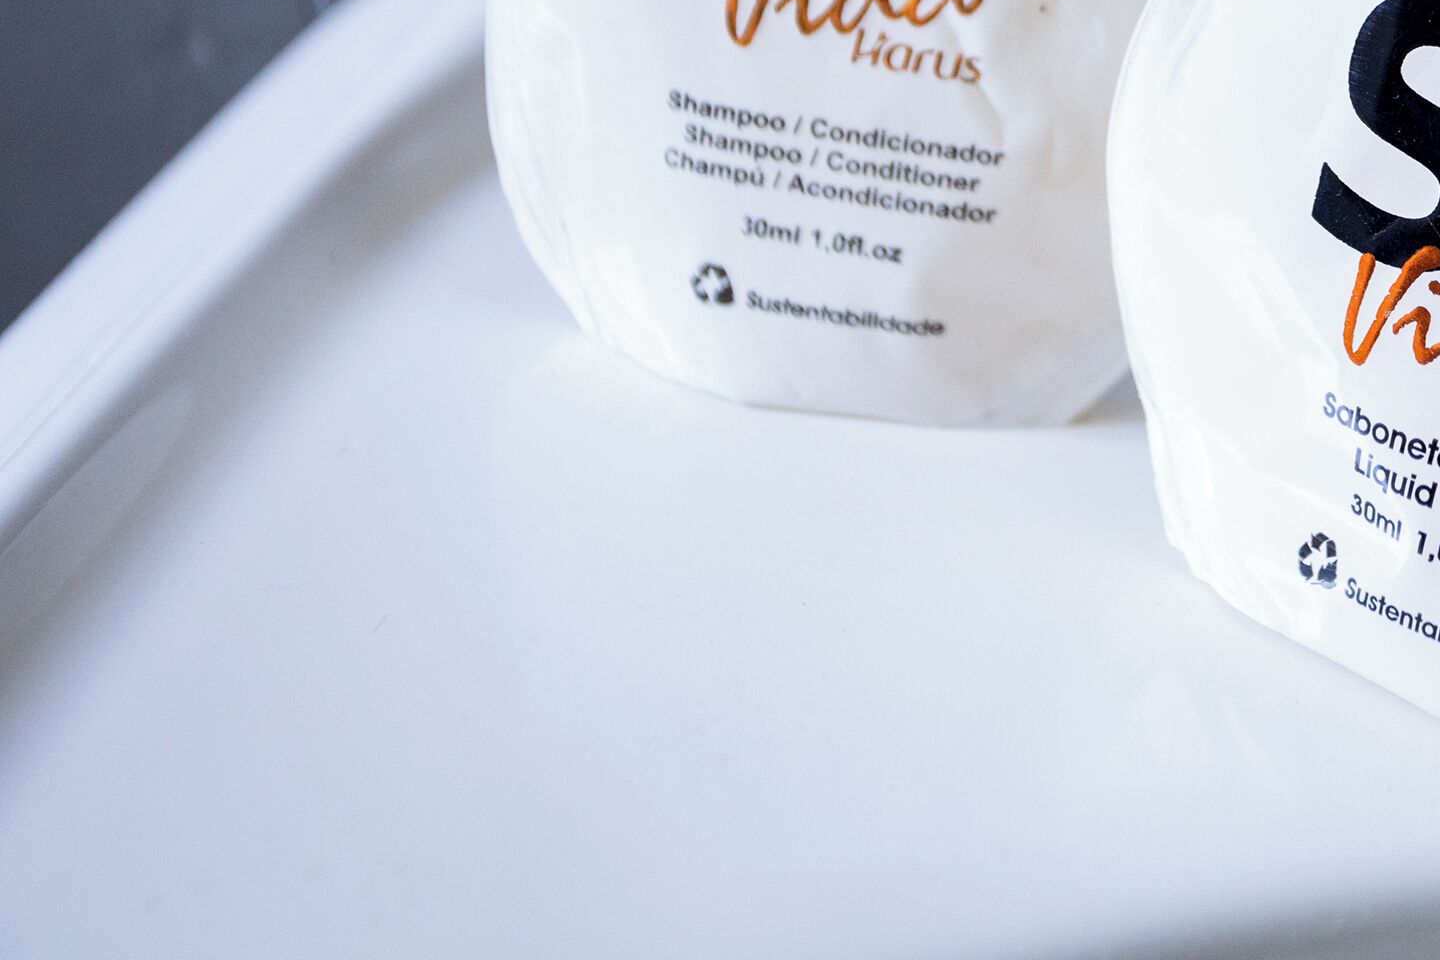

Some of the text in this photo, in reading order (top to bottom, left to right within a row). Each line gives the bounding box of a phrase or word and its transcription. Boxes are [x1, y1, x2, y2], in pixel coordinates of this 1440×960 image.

[668, 90, 787, 133] Shampoo
[810, 118, 1005, 168] Condicionador
[684, 124, 802, 164] Shampoo
[826, 151, 981, 193] Conditioner
[664, 148, 764, 190] Champú
[788, 175, 998, 225] Acondicionador
[741, 215, 802, 246] 30ml
[746, 290, 945, 337] Sustentabilidade
[1353, 446, 1438, 509] Liquid
[1350, 493, 1403, 541] 30ml
